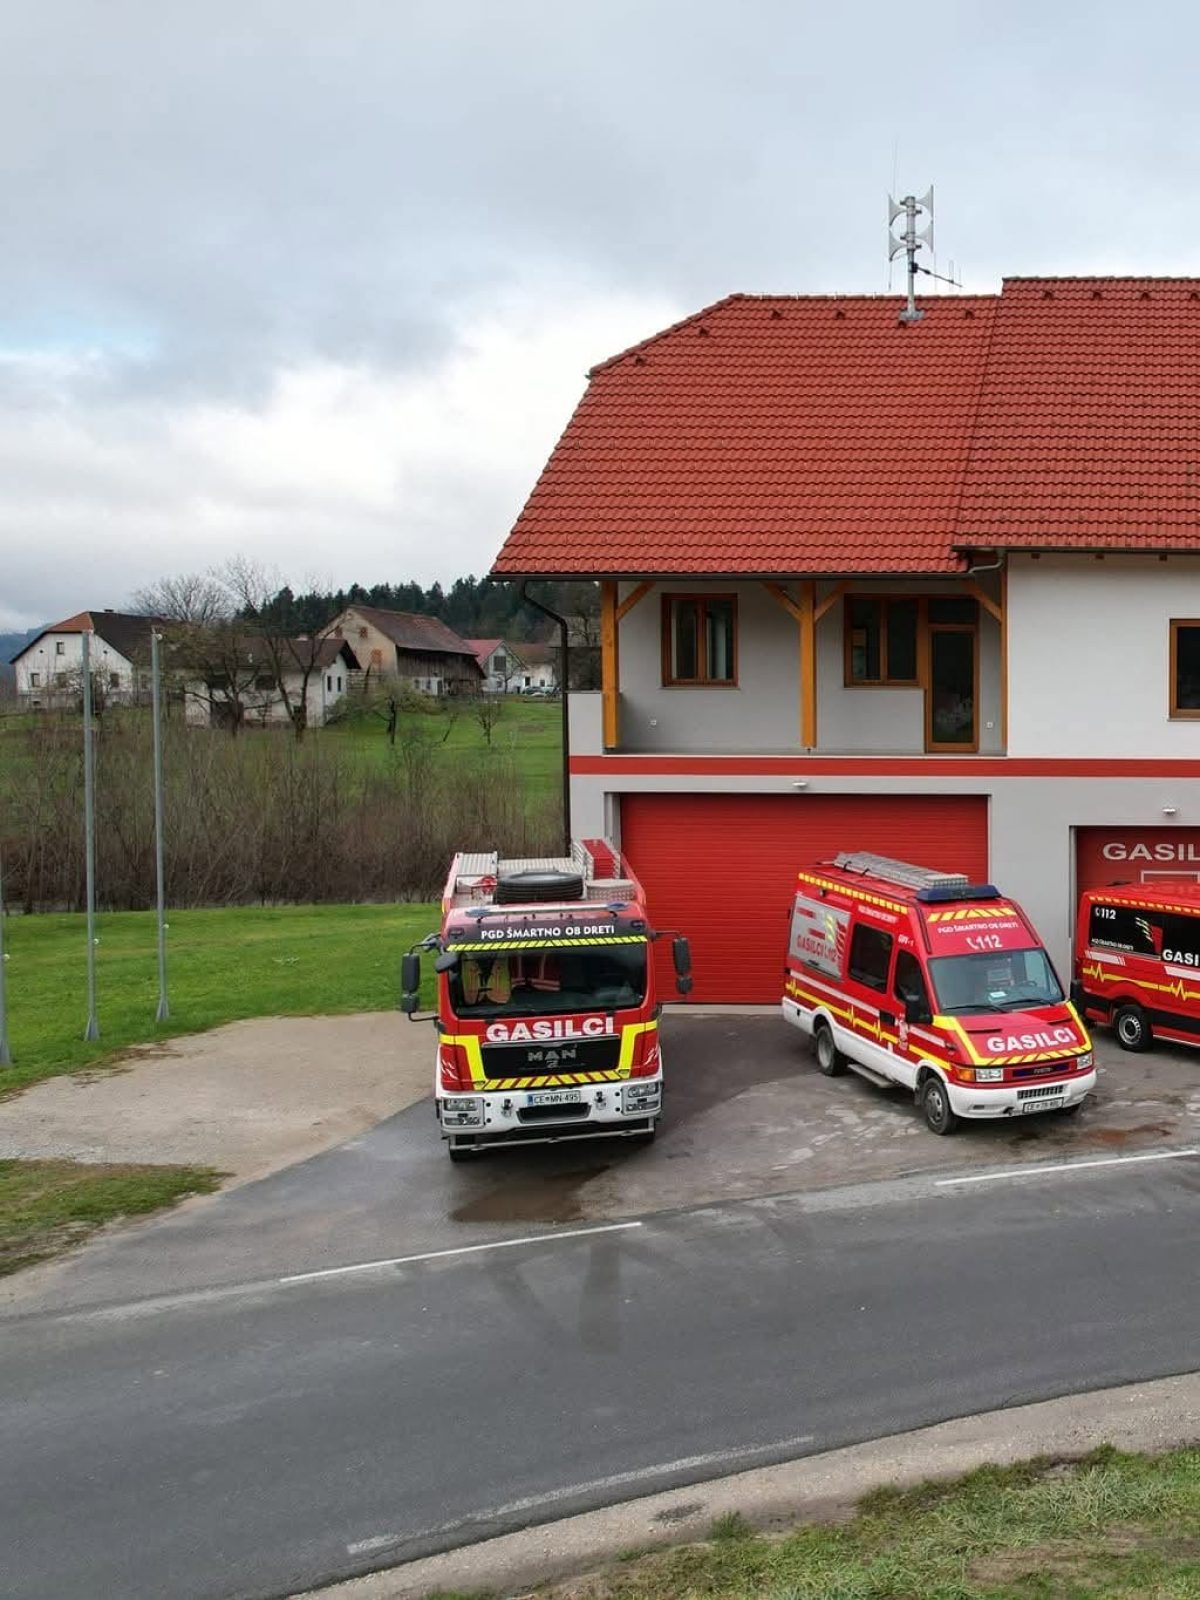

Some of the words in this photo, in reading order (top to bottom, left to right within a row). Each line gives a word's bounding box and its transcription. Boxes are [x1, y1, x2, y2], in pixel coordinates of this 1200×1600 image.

[1101, 907, 1116, 919] 112
[481, 930, 504, 940] PGD
[506, 926, 561, 939] ŠMARTNO
[565, 926, 581, 935] OB
[583, 925, 615, 935] DRETI
[976, 934, 1003, 949] 112
[486, 1017, 614, 1041] GASILCI
[987, 1027, 1077, 1052] GASILCI
[527, 1049, 577, 1062] MAN
